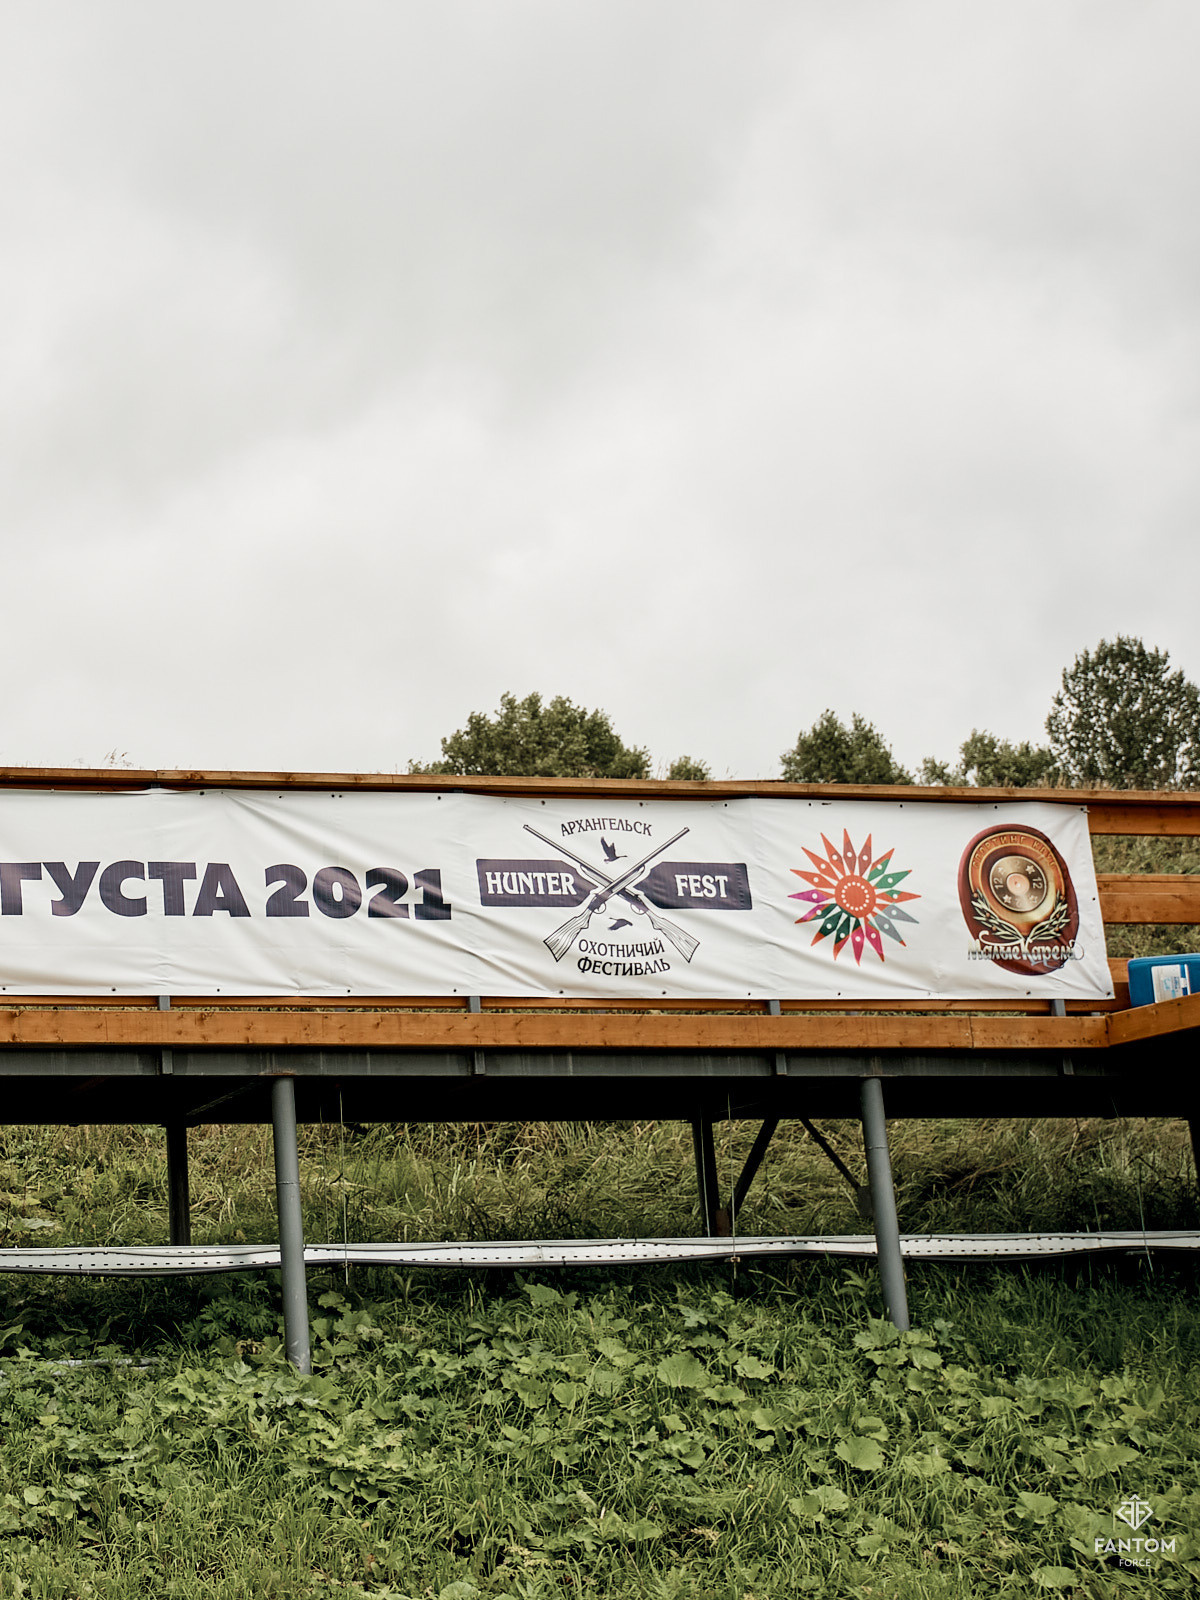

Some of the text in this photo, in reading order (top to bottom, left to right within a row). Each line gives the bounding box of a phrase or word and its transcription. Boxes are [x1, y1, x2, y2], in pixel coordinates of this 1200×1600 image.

[560, 817, 653, 837] АРХАНГЕЛЬСК
[265, 864, 452, 921] 2021
[485, 871, 729, 898] HUNTER FEST
[578, 938, 665, 958] ОХОТНИЧИЙ
[577, 957, 671, 976] ФЕСТИВАЛЬ
